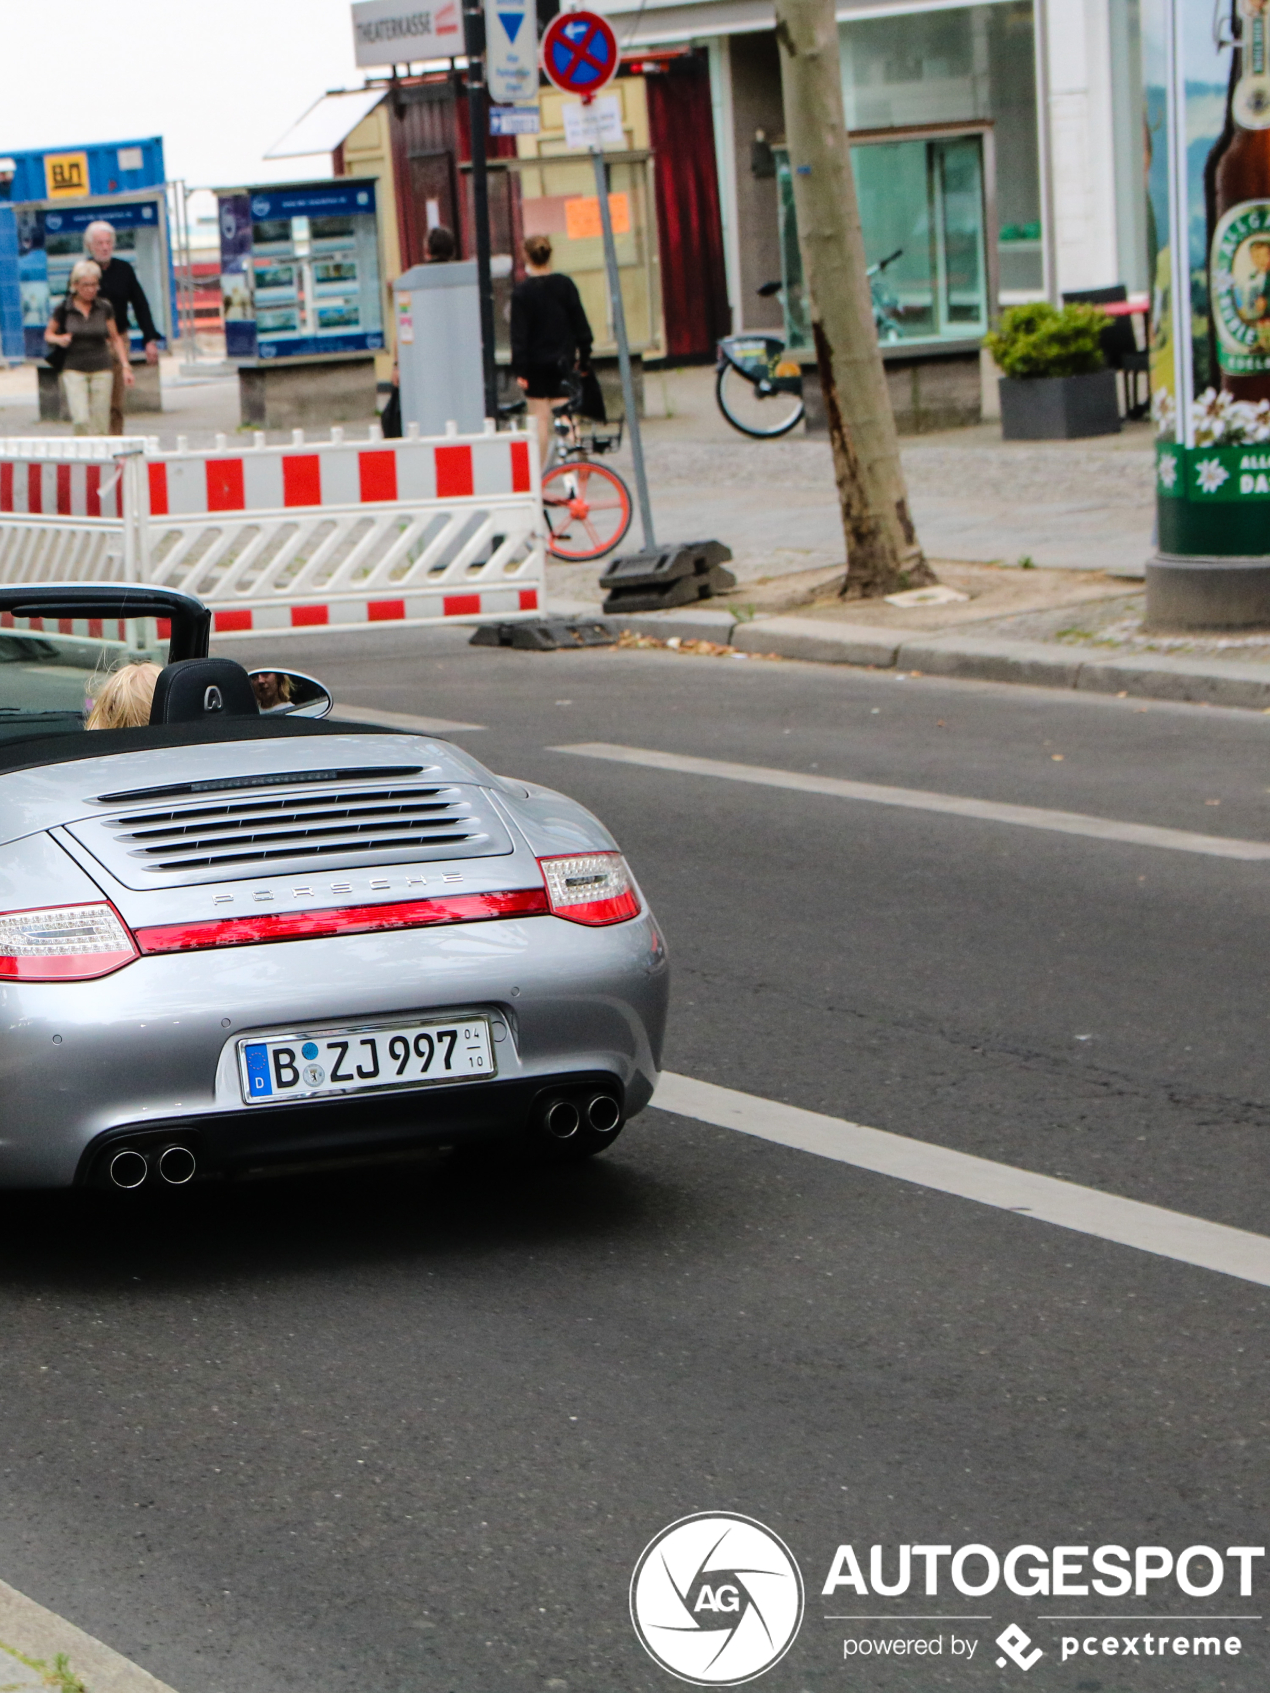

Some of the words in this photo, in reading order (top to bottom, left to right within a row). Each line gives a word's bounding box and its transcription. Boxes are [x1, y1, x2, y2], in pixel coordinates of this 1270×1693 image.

[356, 11, 431, 43] THEATERKASSE
[1240, 473, 1270, 495] DA
[212, 871, 464, 906] PORSCHE
[464, 1028, 480, 1040] 04
[272, 1047, 300, 1089] B
[468, 1056, 484, 1068] 10
[255, 1077, 265, 1089] D
